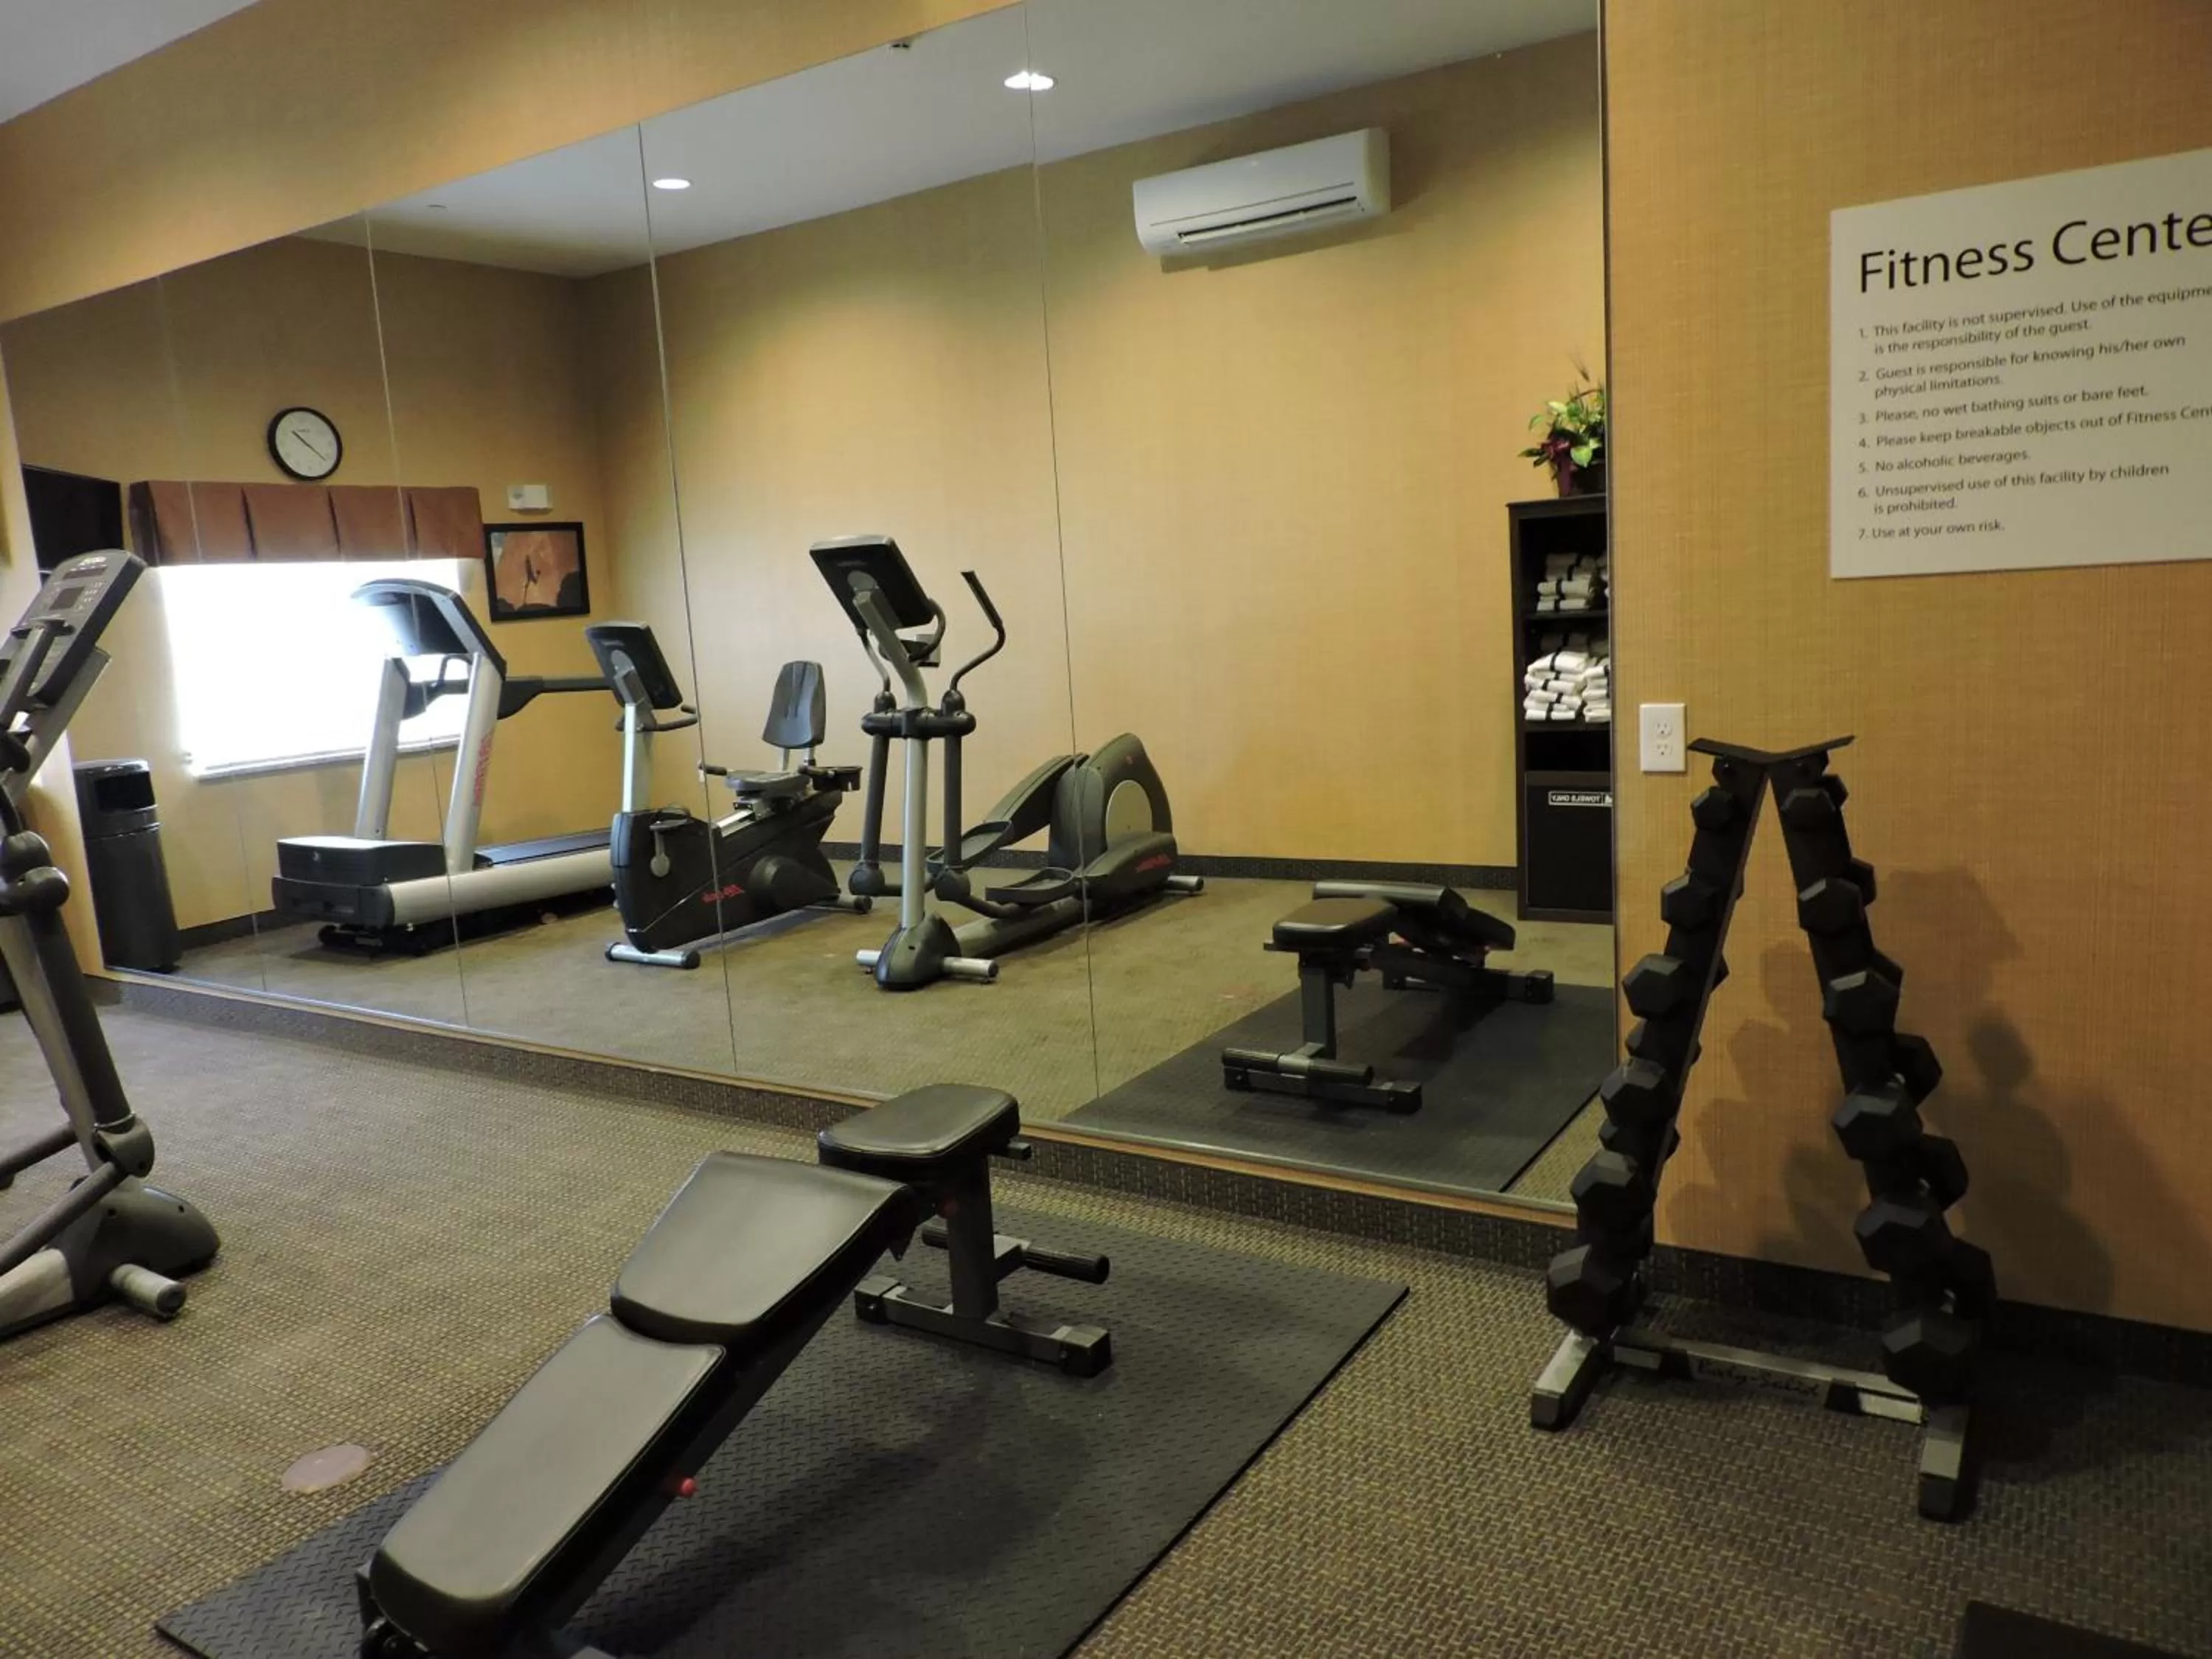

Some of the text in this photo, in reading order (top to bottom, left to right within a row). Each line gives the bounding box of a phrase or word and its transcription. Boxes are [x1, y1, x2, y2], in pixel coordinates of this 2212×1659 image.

[1861, 212, 2212, 293] Fitness Cente
[1873, 324, 1899, 337] This
[1902, 319, 1945, 334] facility
[1949, 317, 1958, 329] is
[1962, 313, 1985, 327] not
[2071, 300, 2098, 313] Use
[2101, 295, 2116, 310] of
[2120, 293, 2144, 307] the
[1874, 343, 1885, 355] is
[1888, 341, 1909, 354] the
[1912, 330, 2001, 352] responsibility
[2005, 324, 2020, 339] of
[2023, 324, 2045, 338] the
[1876, 366, 1913, 380] Guest
[1916, 364, 1926, 377] is
[1930, 354, 2007, 375] responsible
[2010, 352, 2029, 366] for
[2033, 347, 2094, 362] knowing
[2098, 339, 2149, 354] his/her
[2152, 336, 2185, 349] own
[1875, 380, 1927, 400] physical
[1922, 408, 1940, 418] no
[1943, 403, 1969, 416] wet
[1971, 399, 2025, 413] bathing
[2028, 394, 2060, 408] suits
[2063, 394, 2078, 404] or
[2081, 389, 2114, 402] bare
[1876, 435, 1918, 447] Please
[1920, 431, 1952, 444] keep
[1955, 423, 2023, 440] breakable
[2025, 419, 2076, 437] objects
[2079, 417, 2104, 429] out
[2107, 412, 2124, 427] of
[2126, 411, 2177, 425] Fitness
[1875, 460, 1894, 472] No
[1896, 455, 1954, 472] alcoholic
[1876, 478, 1964, 498] Unsupervised
[1967, 479, 1991, 491] use
[1994, 475, 2008, 488] of
[2011, 474, 2035, 487] this
[2039, 470, 2085, 484] facility
[2089, 468, 2106, 483] by
[2110, 464, 2169, 479] children
[1874, 506, 1884, 515] is
[1871, 528, 1896, 539] Use
[1899, 526, 1911, 538] at
[1913, 524, 1943, 539] your
[1946, 523, 1975, 535] own
